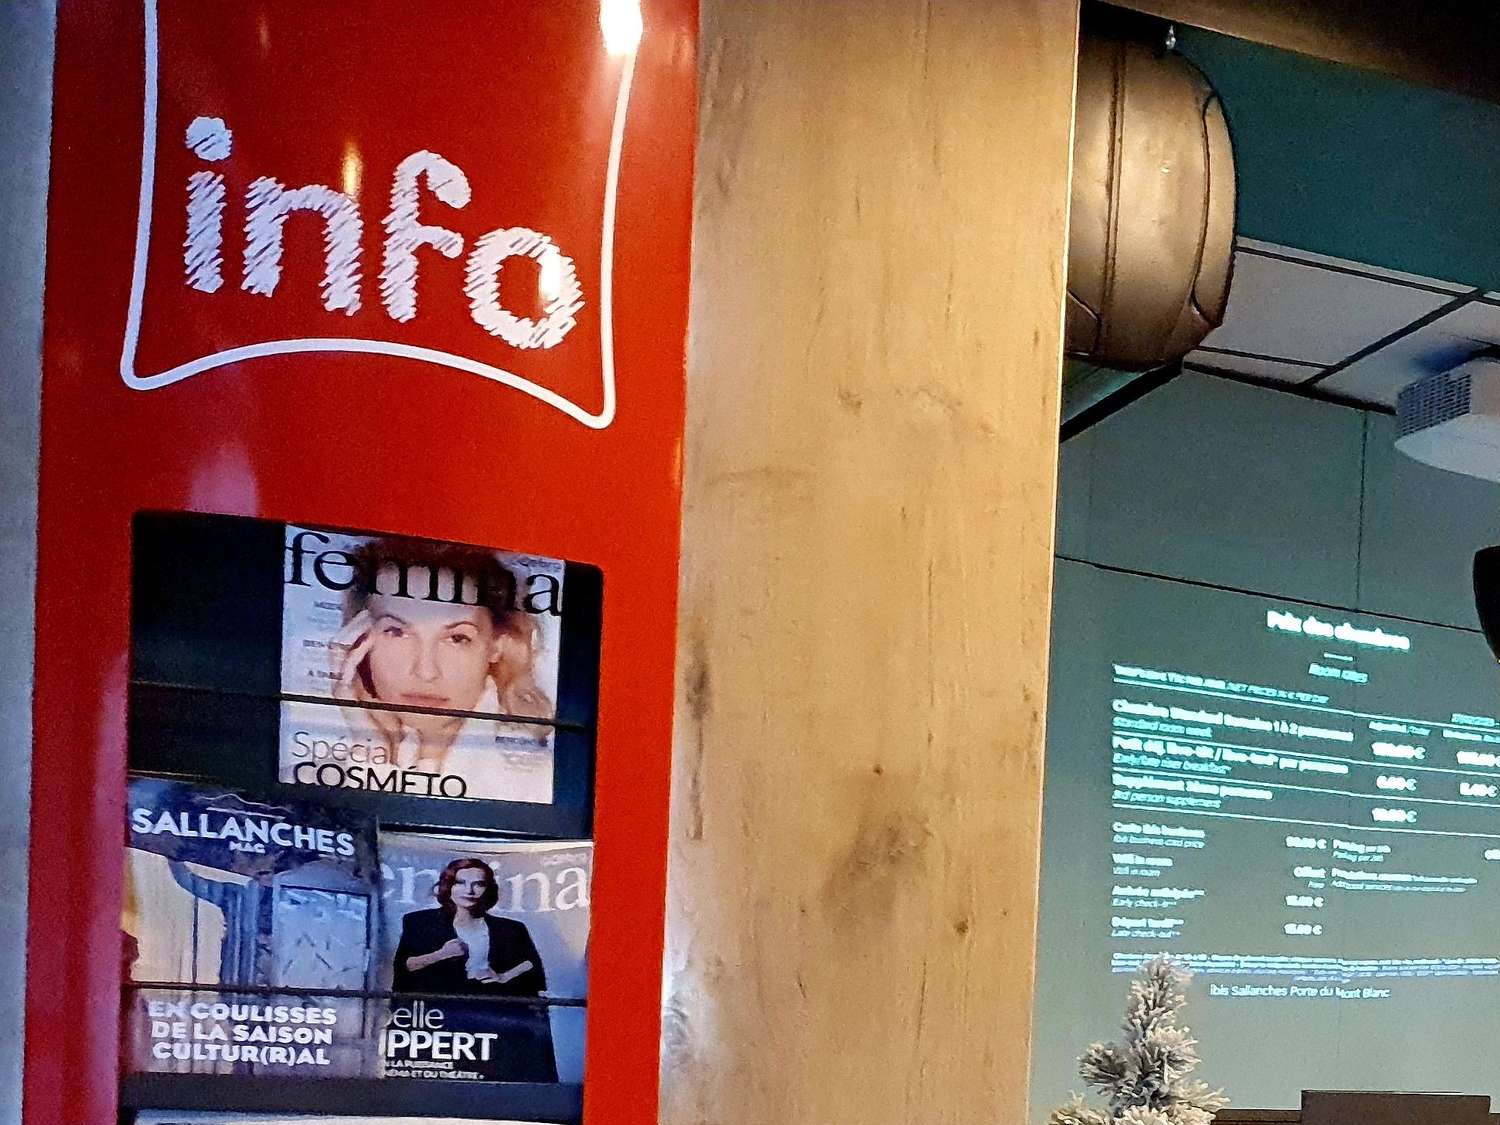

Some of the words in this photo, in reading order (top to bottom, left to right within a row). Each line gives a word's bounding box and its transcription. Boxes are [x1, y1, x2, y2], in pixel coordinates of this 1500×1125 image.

[183, 115, 586, 350] info
[131, 807, 355, 856] SALLANCHES
[149, 1000, 187, 1018] EN
[190, 1002, 337, 1025] COULISSES
[152, 1021, 187, 1039] DE
[193, 1023, 229, 1042] LA
[233, 1024, 333, 1045] SAISON
[152, 1042, 331, 1066] CULTUR(R)AL
